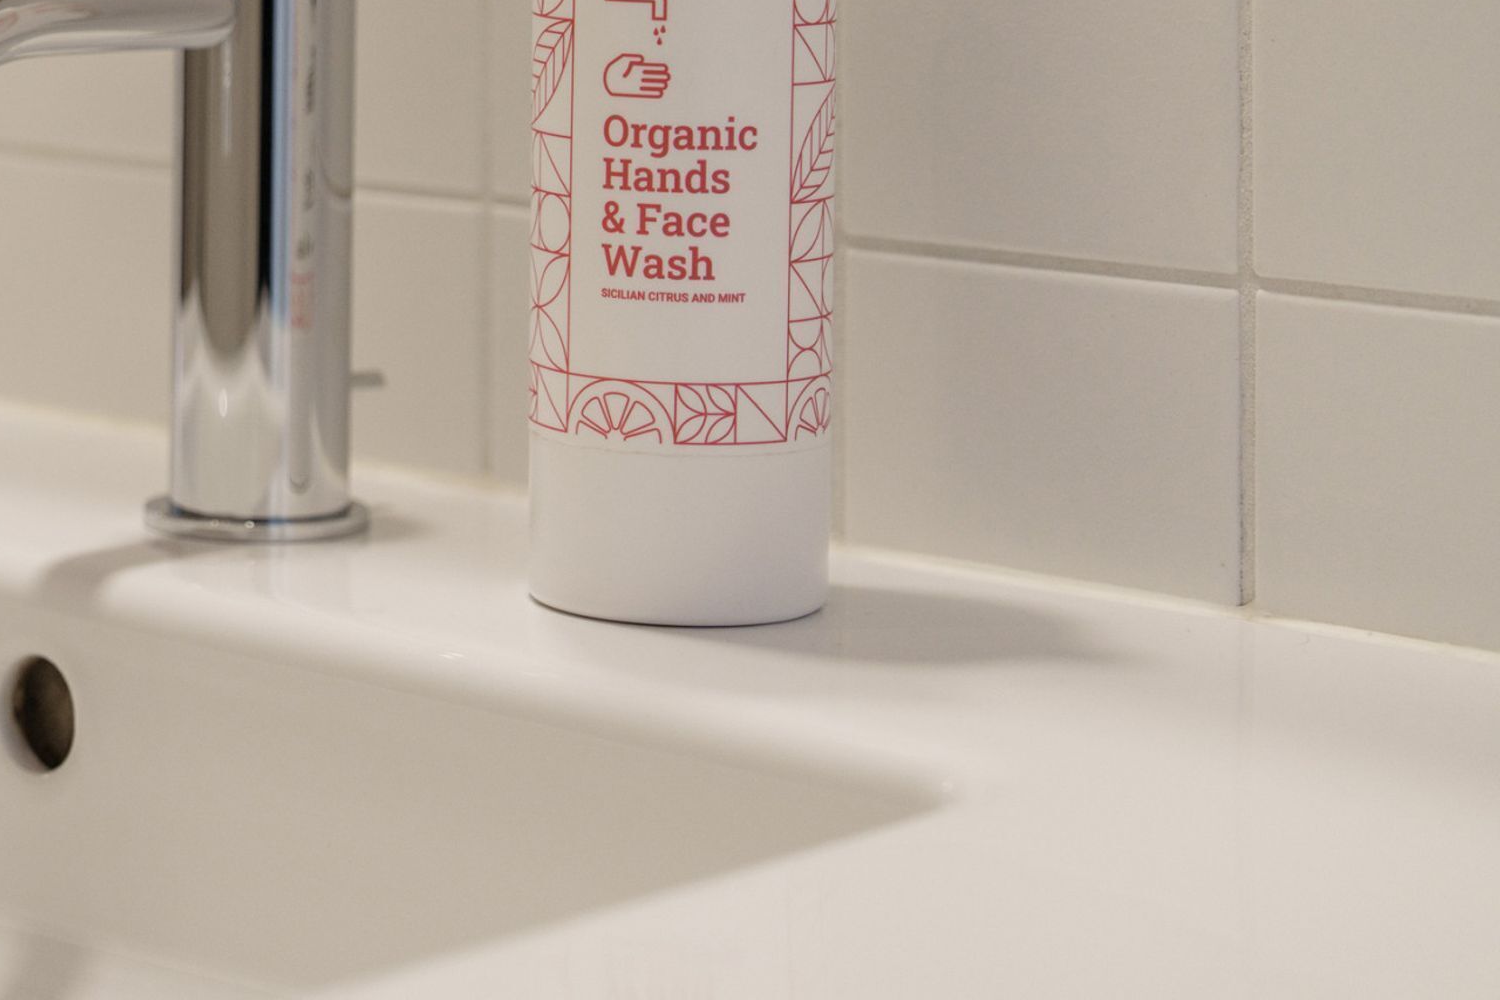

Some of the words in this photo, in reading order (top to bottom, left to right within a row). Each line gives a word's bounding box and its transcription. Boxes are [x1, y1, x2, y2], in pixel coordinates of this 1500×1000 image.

[603, 114, 758, 158] Organic
[602, 157, 730, 193] Hands
[601, 201, 625, 234] &
[636, 203, 730, 237] Face
[601, 243, 715, 281] Wash
[601, 288, 645, 301] SICILIAN
[649, 292, 689, 303] CITRUS
[691, 293, 716, 303] AND
[718, 293, 746, 304] MINT
